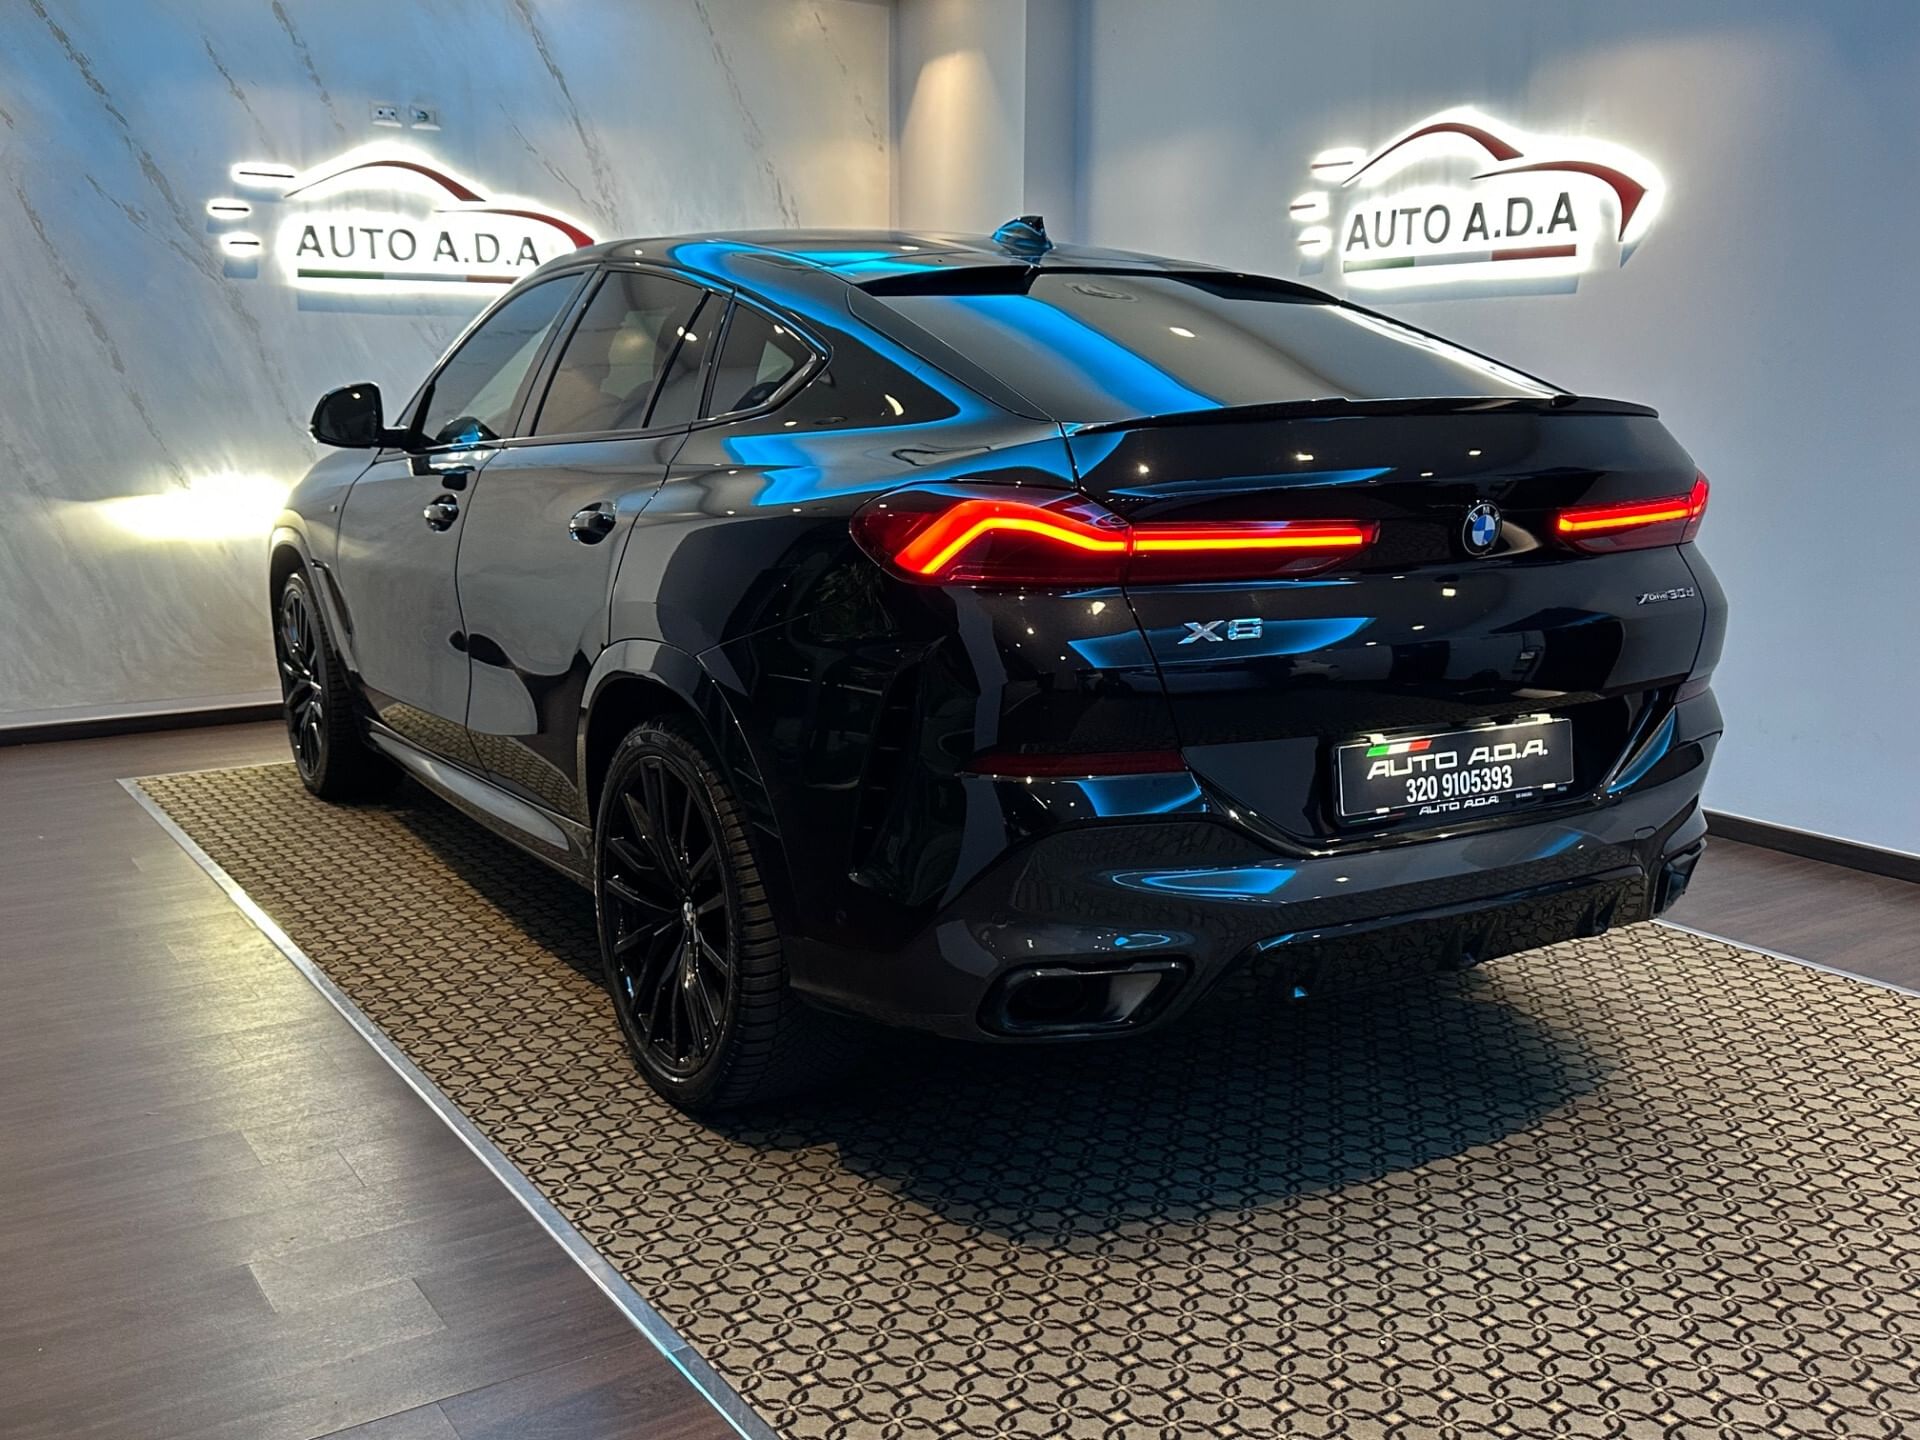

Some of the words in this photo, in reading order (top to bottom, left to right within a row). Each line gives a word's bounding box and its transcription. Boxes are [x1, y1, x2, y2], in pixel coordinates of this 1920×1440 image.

[1345, 204, 1451, 252] AUTO
[1463, 191, 1577, 242] A.D.A
[296, 225, 417, 261] AUTO
[433, 231, 542, 266] A.D.A
[1470, 506, 1500, 522] BMW
[1177, 617, 1264, 645] X6
[1366, 751, 1458, 780] AUTO
[1467, 739, 1549, 766] A.D.A.
[1406, 775, 1438, 803] 320
[1442, 764, 1513, 797] 9105393
[1418, 803, 1460, 816] AUTO
